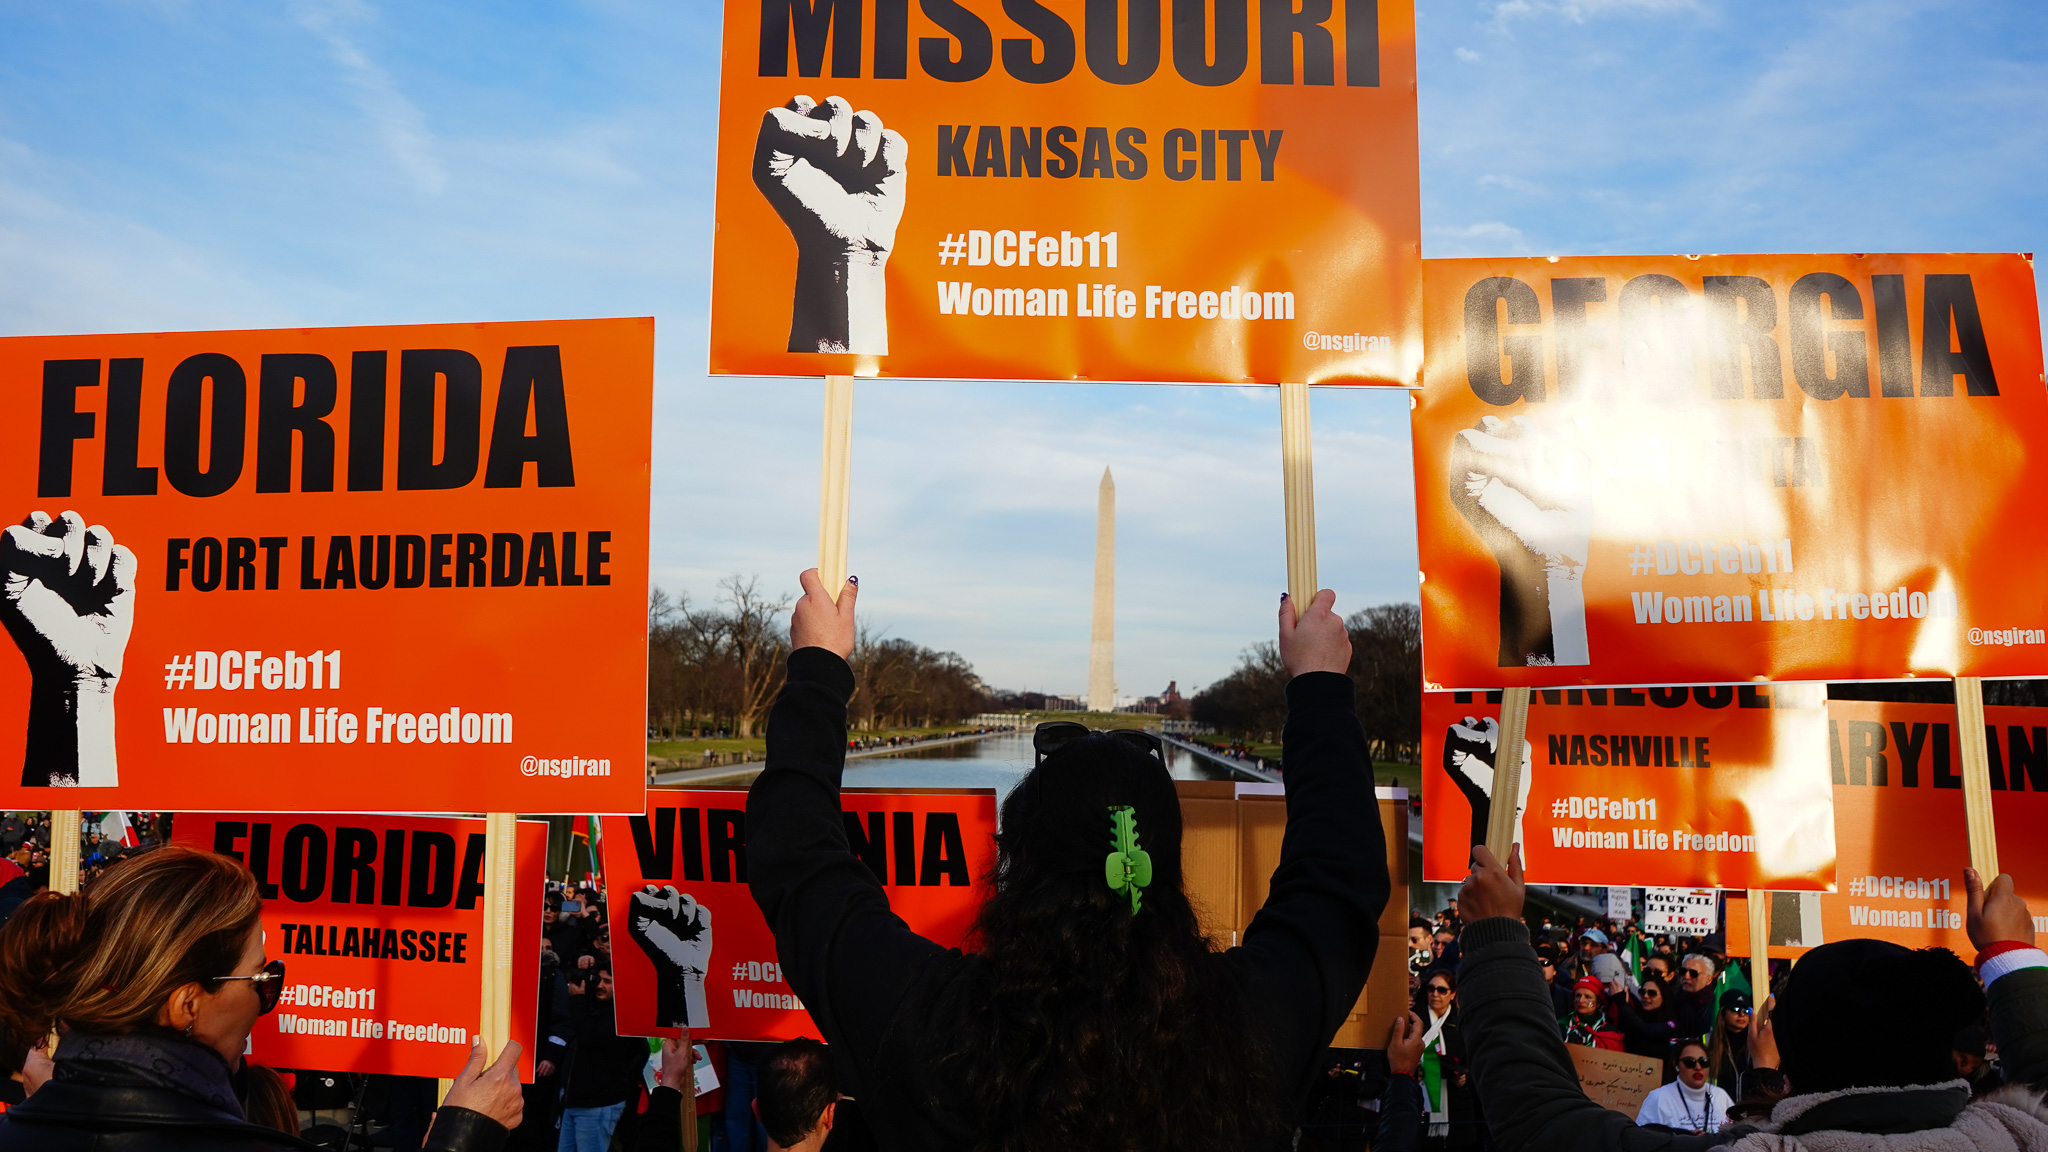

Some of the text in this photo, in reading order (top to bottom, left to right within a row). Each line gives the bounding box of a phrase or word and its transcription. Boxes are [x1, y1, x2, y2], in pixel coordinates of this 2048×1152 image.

[758, 0, 1381, 87] MISSOURI
[936, 125, 1284, 182] KANSAS CITY
[937, 230, 1119, 269] #DCFeb11
[937, 281, 1296, 321] Woman Life Freedom
[1303, 331, 1391, 353] @nsgiran
[37, 345, 576, 498] FLORIDA
[165, 531, 612, 592] FORT LAUDERDALE
[1628, 538, 1794, 576] #DCFeb11
[1631, 587, 1958, 625] Woman Life Freedom
[1967, 627, 2046, 647] @nsgiran
[163, 650, 341, 691] #DCFeb11
[163, 707, 513, 744] Woman Life Freedom
[520, 756, 611, 777] @nsgiran
[1548, 734, 1711, 768] NASHVILLE
[1551, 796, 1657, 821] #DCFeb11
[628, 807, 971, 887] VIRNIA
[1552, 827, 1759, 853] Woman Life Freedom
[1646, 894, 1713, 906] COUNCIL
[1849, 875, 1950, 900] #DCFeb11
[1648, 904, 1688, 914] LIST
[1667, 915, 1709, 925] IRGC
[1849, 906, 1962, 929] Woman Life
[280, 923, 467, 963] TALLAHASSEE
[1645, 924, 1714, 934] TERRORIST
[279, 984, 376, 1010] #DCFeb11
[278, 1014, 466, 1045] Woman Life Freedom
